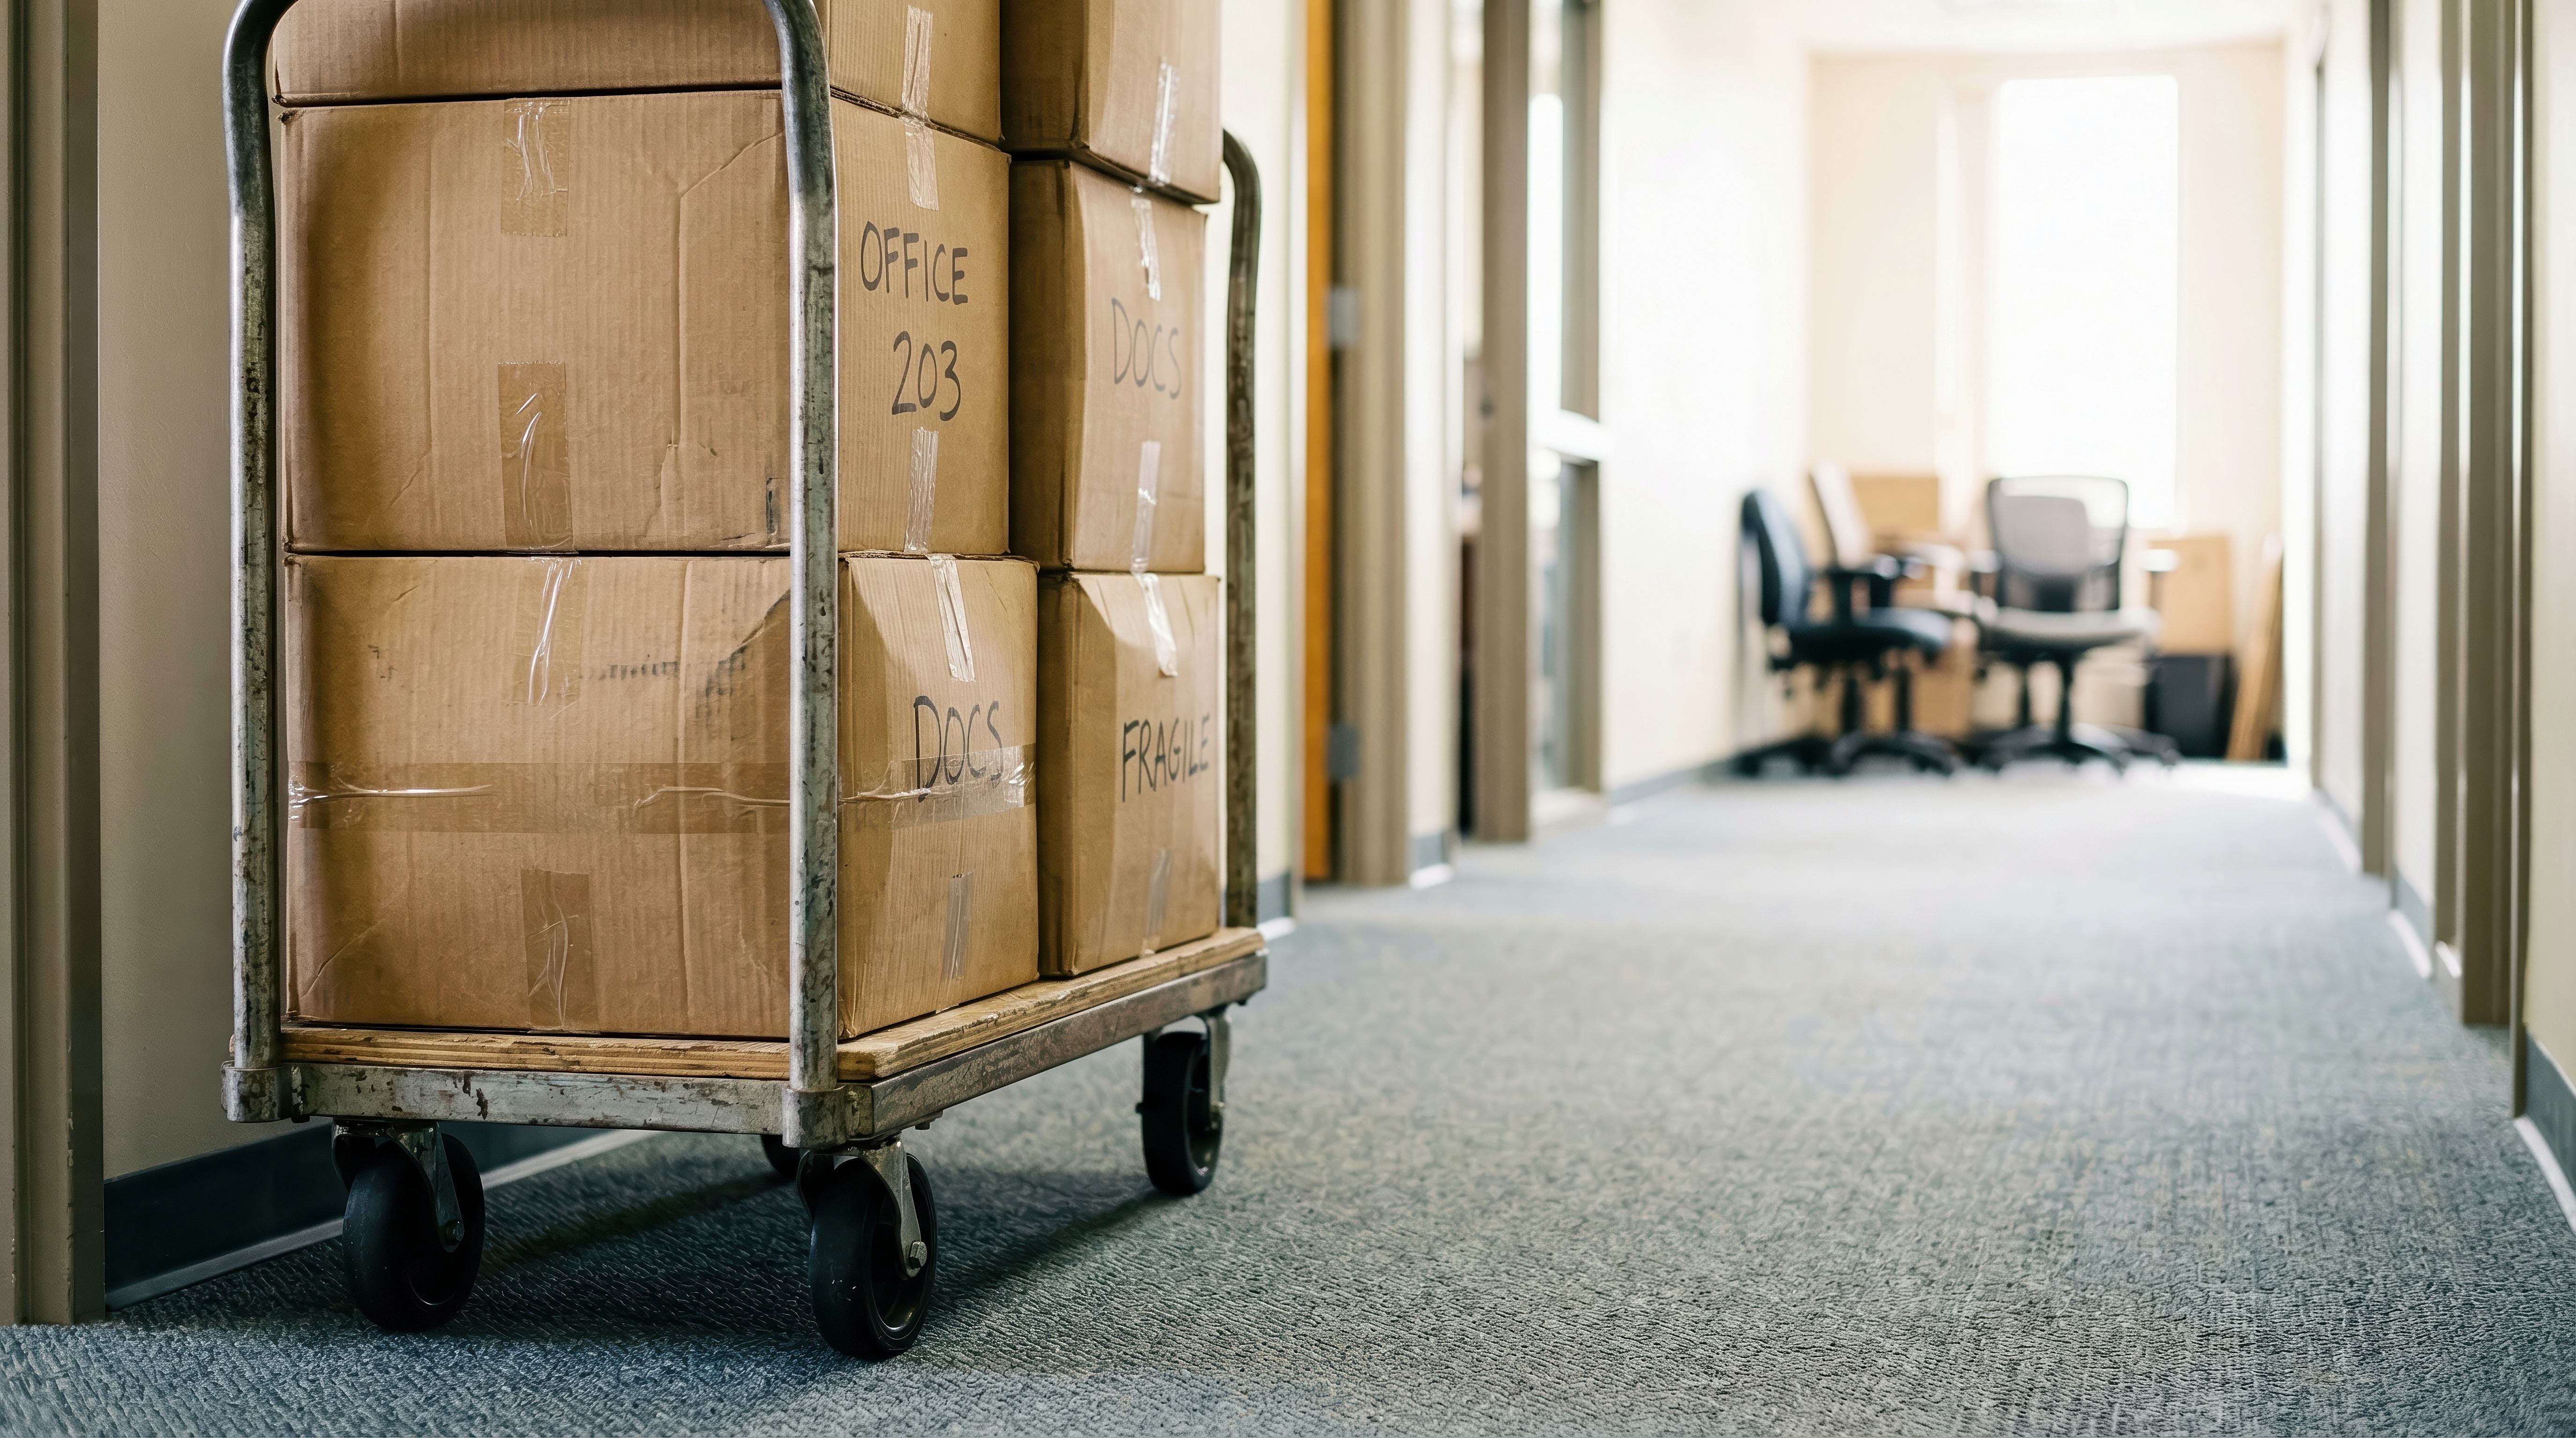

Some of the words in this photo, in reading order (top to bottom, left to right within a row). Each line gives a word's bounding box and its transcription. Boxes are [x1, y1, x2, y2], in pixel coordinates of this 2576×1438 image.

[861, 221, 968, 305] OFFICE
[892, 331, 961, 421] 203
[1112, 297, 1181, 399] DOCS
[913, 696, 1003, 803] DOCS
[1122, 712, 1210, 802] FRAGILE
